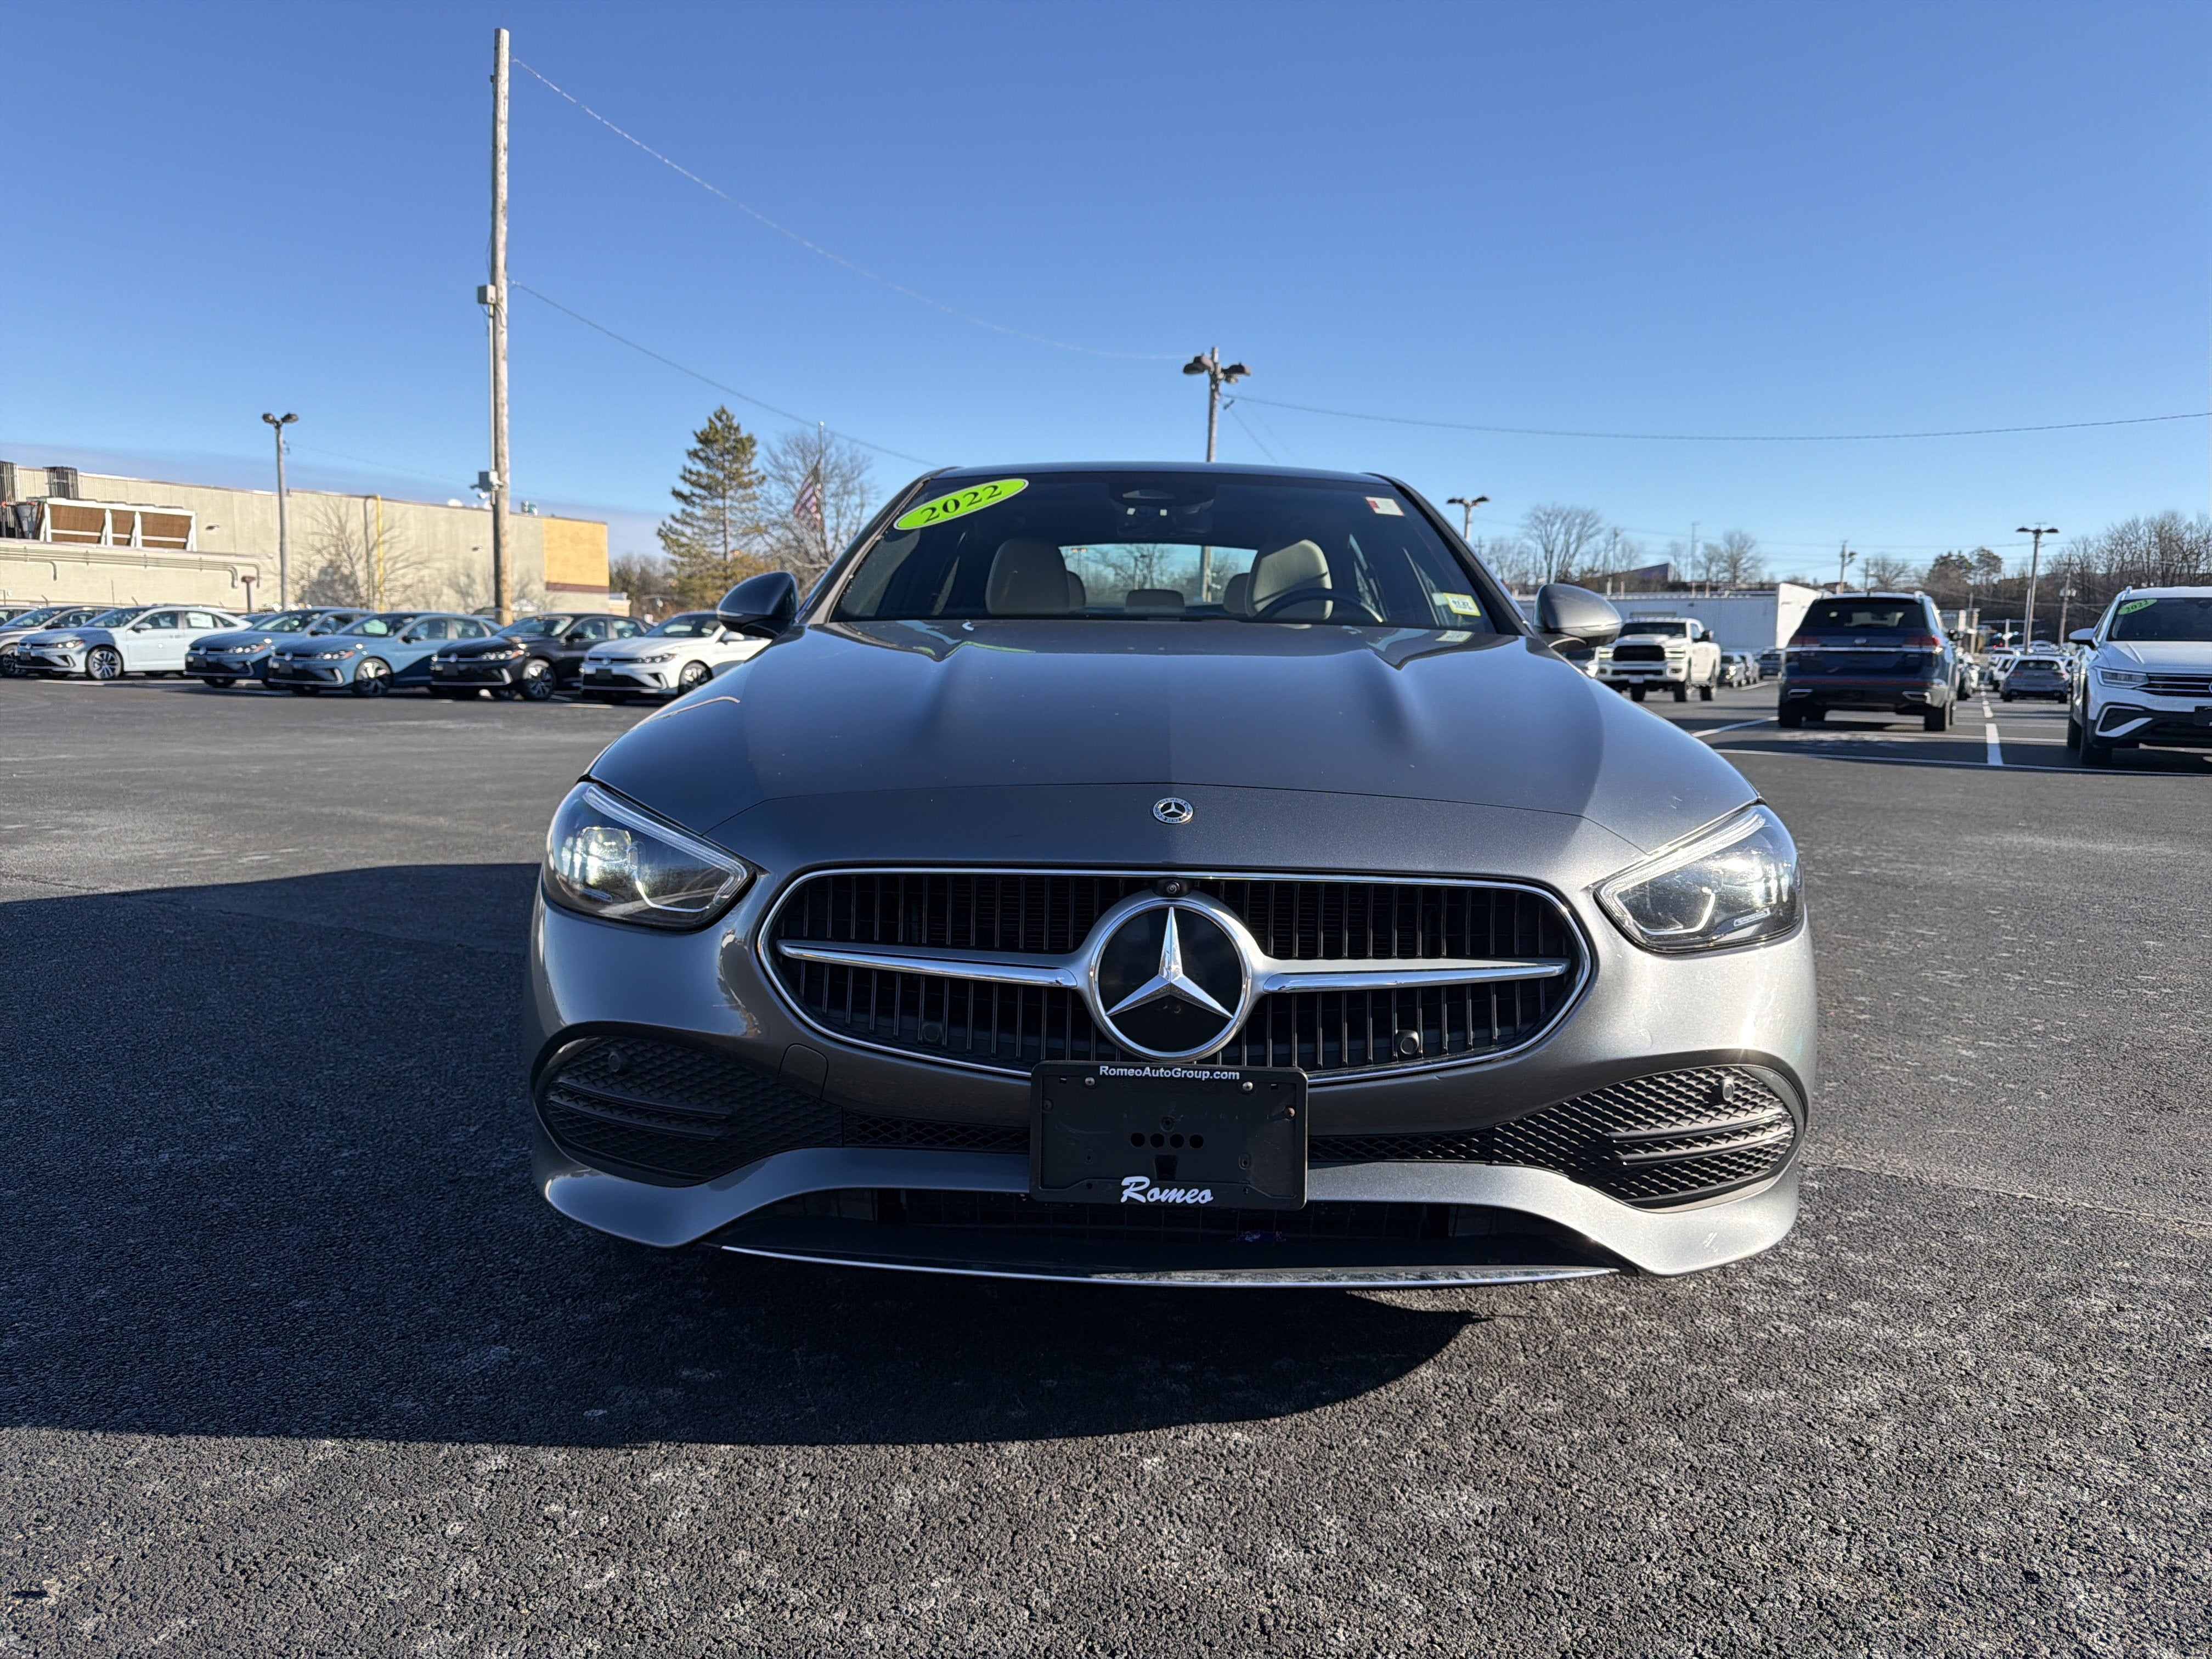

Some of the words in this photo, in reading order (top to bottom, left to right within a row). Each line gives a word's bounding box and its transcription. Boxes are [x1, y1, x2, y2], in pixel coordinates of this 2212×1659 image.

[921, 485, 1002, 523] 2022
[1099, 1066, 1240, 1081] RomeoAutoGroup.com
[1120, 1176, 1214, 1204] Romeo
